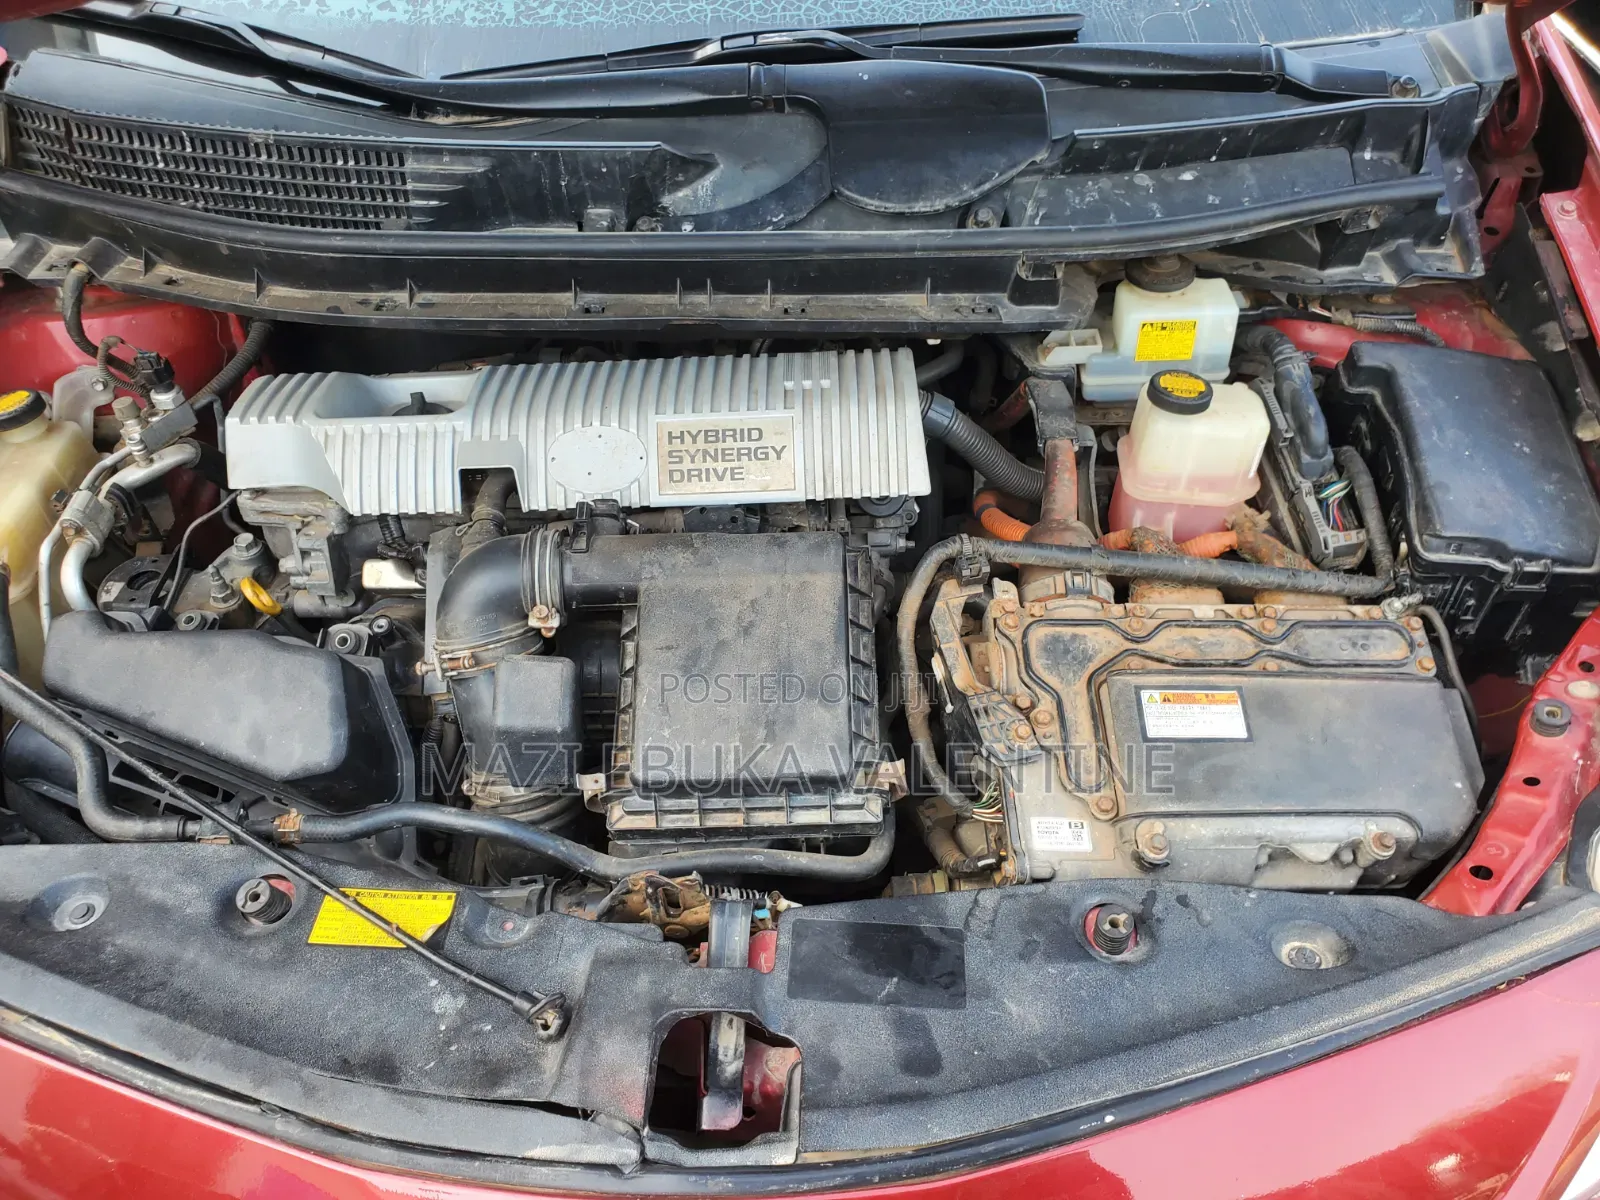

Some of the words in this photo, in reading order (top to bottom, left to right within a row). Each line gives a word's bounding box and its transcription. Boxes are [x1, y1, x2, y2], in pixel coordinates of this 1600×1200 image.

[667, 427, 764, 446] HYBRID
[667, 444, 787, 465] SYNERGY
[668, 466, 745, 484] DRIVE
[359, 891, 385, 899] CAUTION
